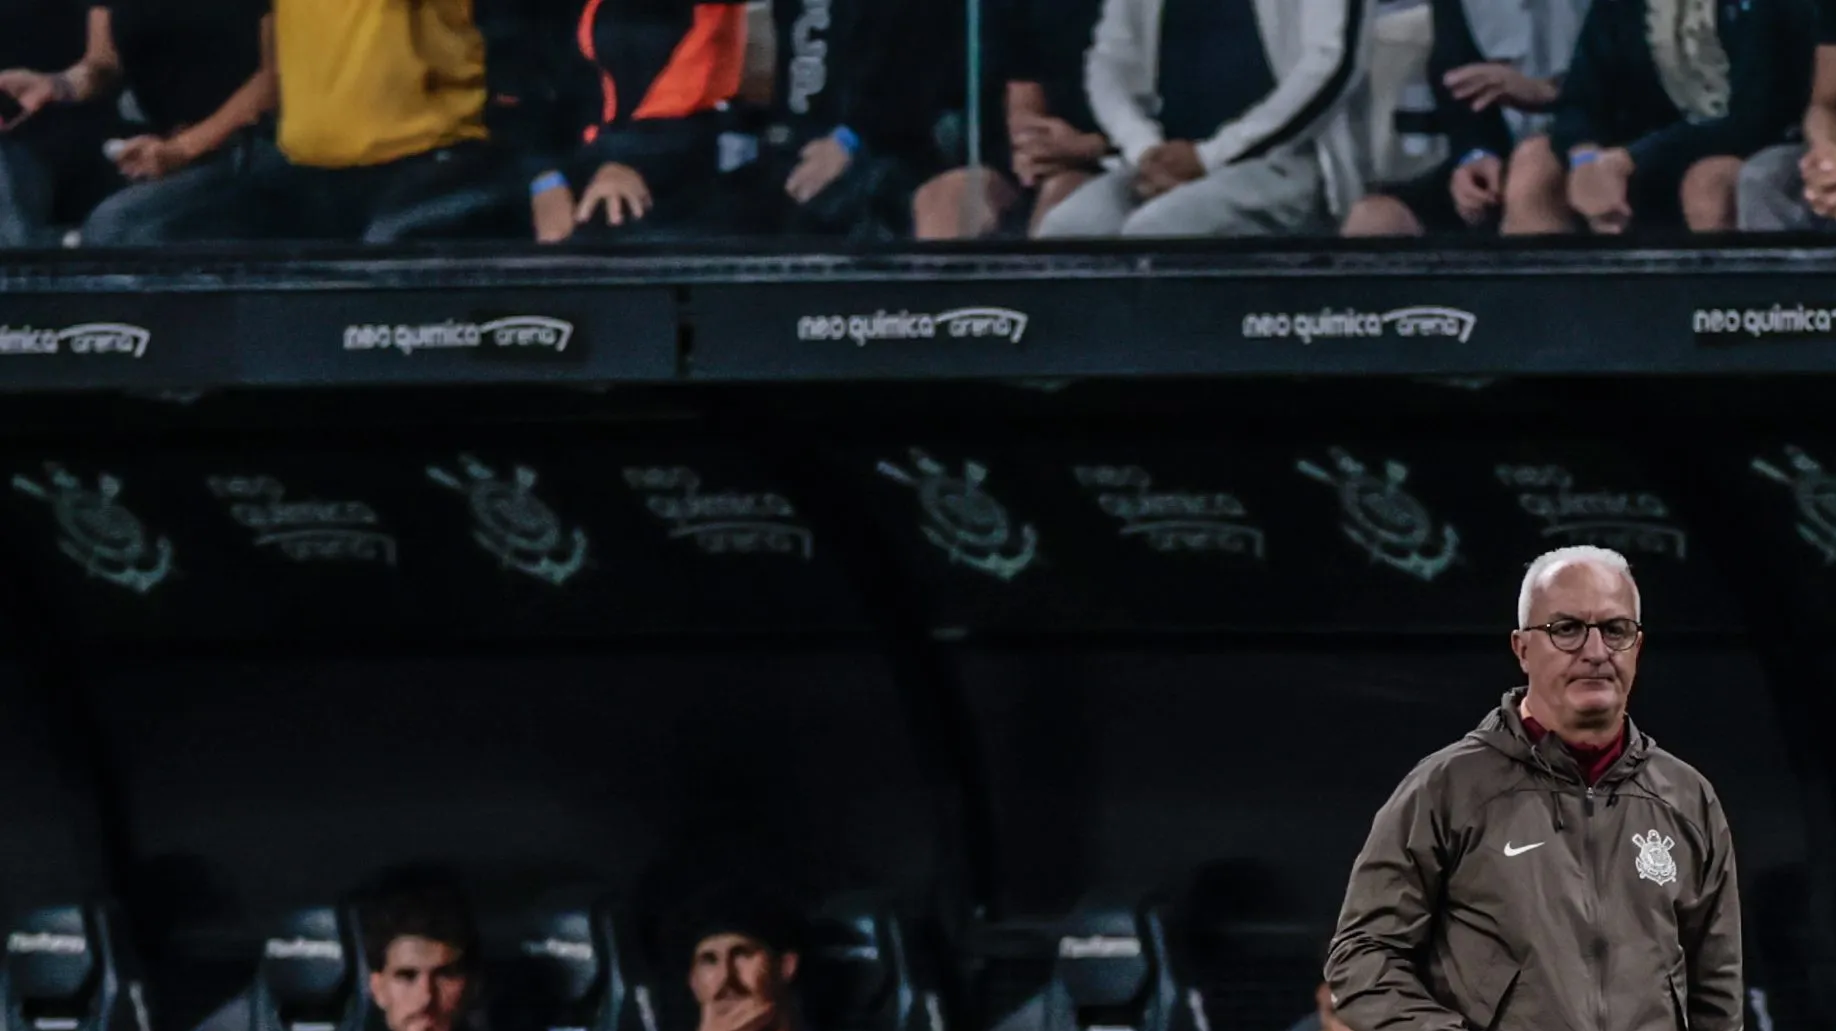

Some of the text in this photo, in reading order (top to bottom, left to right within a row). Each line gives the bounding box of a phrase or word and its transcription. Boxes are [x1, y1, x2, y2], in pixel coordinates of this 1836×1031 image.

[1242, 312, 1291, 338] neo
[1395, 317, 1459, 338] arena
[1693, 308, 1741, 334] neo
